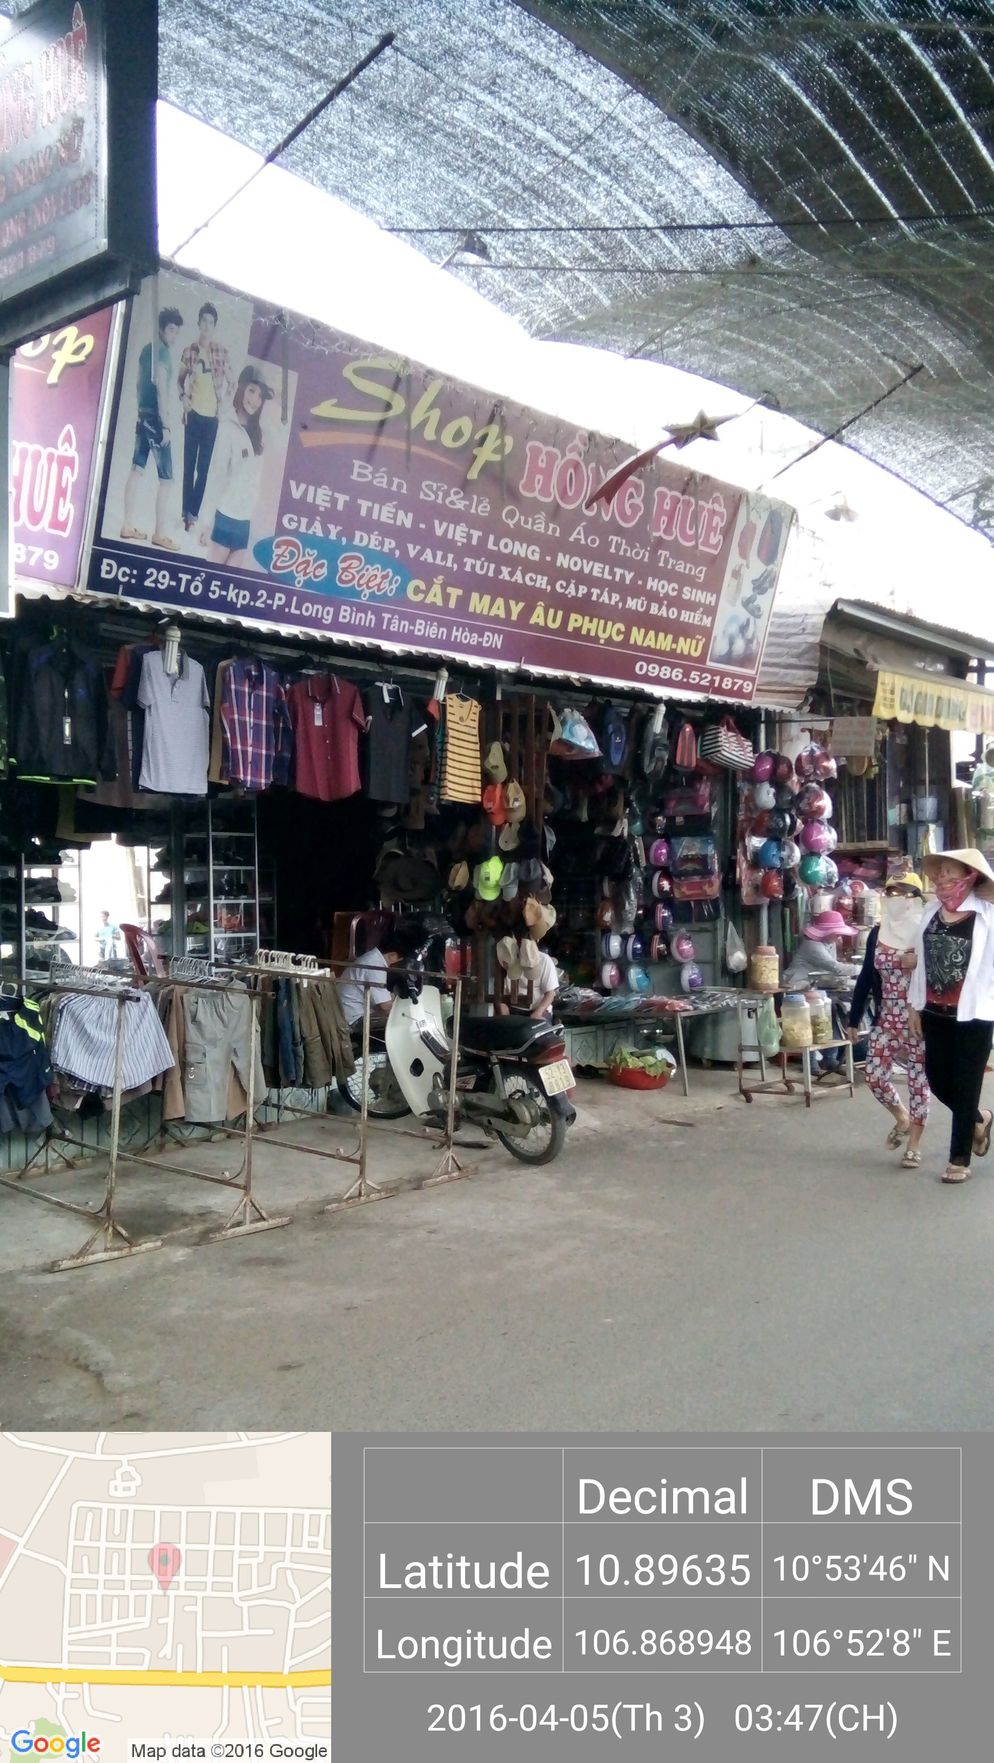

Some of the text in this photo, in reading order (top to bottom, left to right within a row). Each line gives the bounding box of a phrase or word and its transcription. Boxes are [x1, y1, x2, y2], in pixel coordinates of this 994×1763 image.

[0, 1, 87, 150] NG HUÊ
[310, 357, 514, 480] Shop
[271, 537, 401, 601] Đặc Biệt:
[281, 513, 712, 627] GIÀY, DÉP, VALI, TÚI XÁCH, CẶP TÁP, MŨ BẢO HIỂM
[289, 480, 349, 511] VIỆT
[357, 498, 413, 529] TIẾN
[433, 519, 482, 546] VIỆT
[487, 534, 540, 562] LONG
[556, 552, 635, 584] NOVELTY
[646, 576, 679, 598] HỌC
[681, 586, 717, 607] SINH
[350, 459, 407, 494] Bán
[501, 505, 561, 537] Quần
[568, 522, 600, 548] Áo
[608, 535, 650, 563] Thời
[657, 549, 707, 582] Trang
[651, 493, 727, 555] HUÊ
[101, 558, 138, 584] Đc:
[144, 567, 205, 596] 29-Tổ
[338, 605, 376, 628] Bình
[381, 612, 447, 641] Tân-Biên
[451, 625, 504, 650] Hòa-ĐN
[406, 575, 706, 657] CẮT MAY ÂU PHỤC NAM-NỮ
[635, 660, 754, 693] 0986.521879
